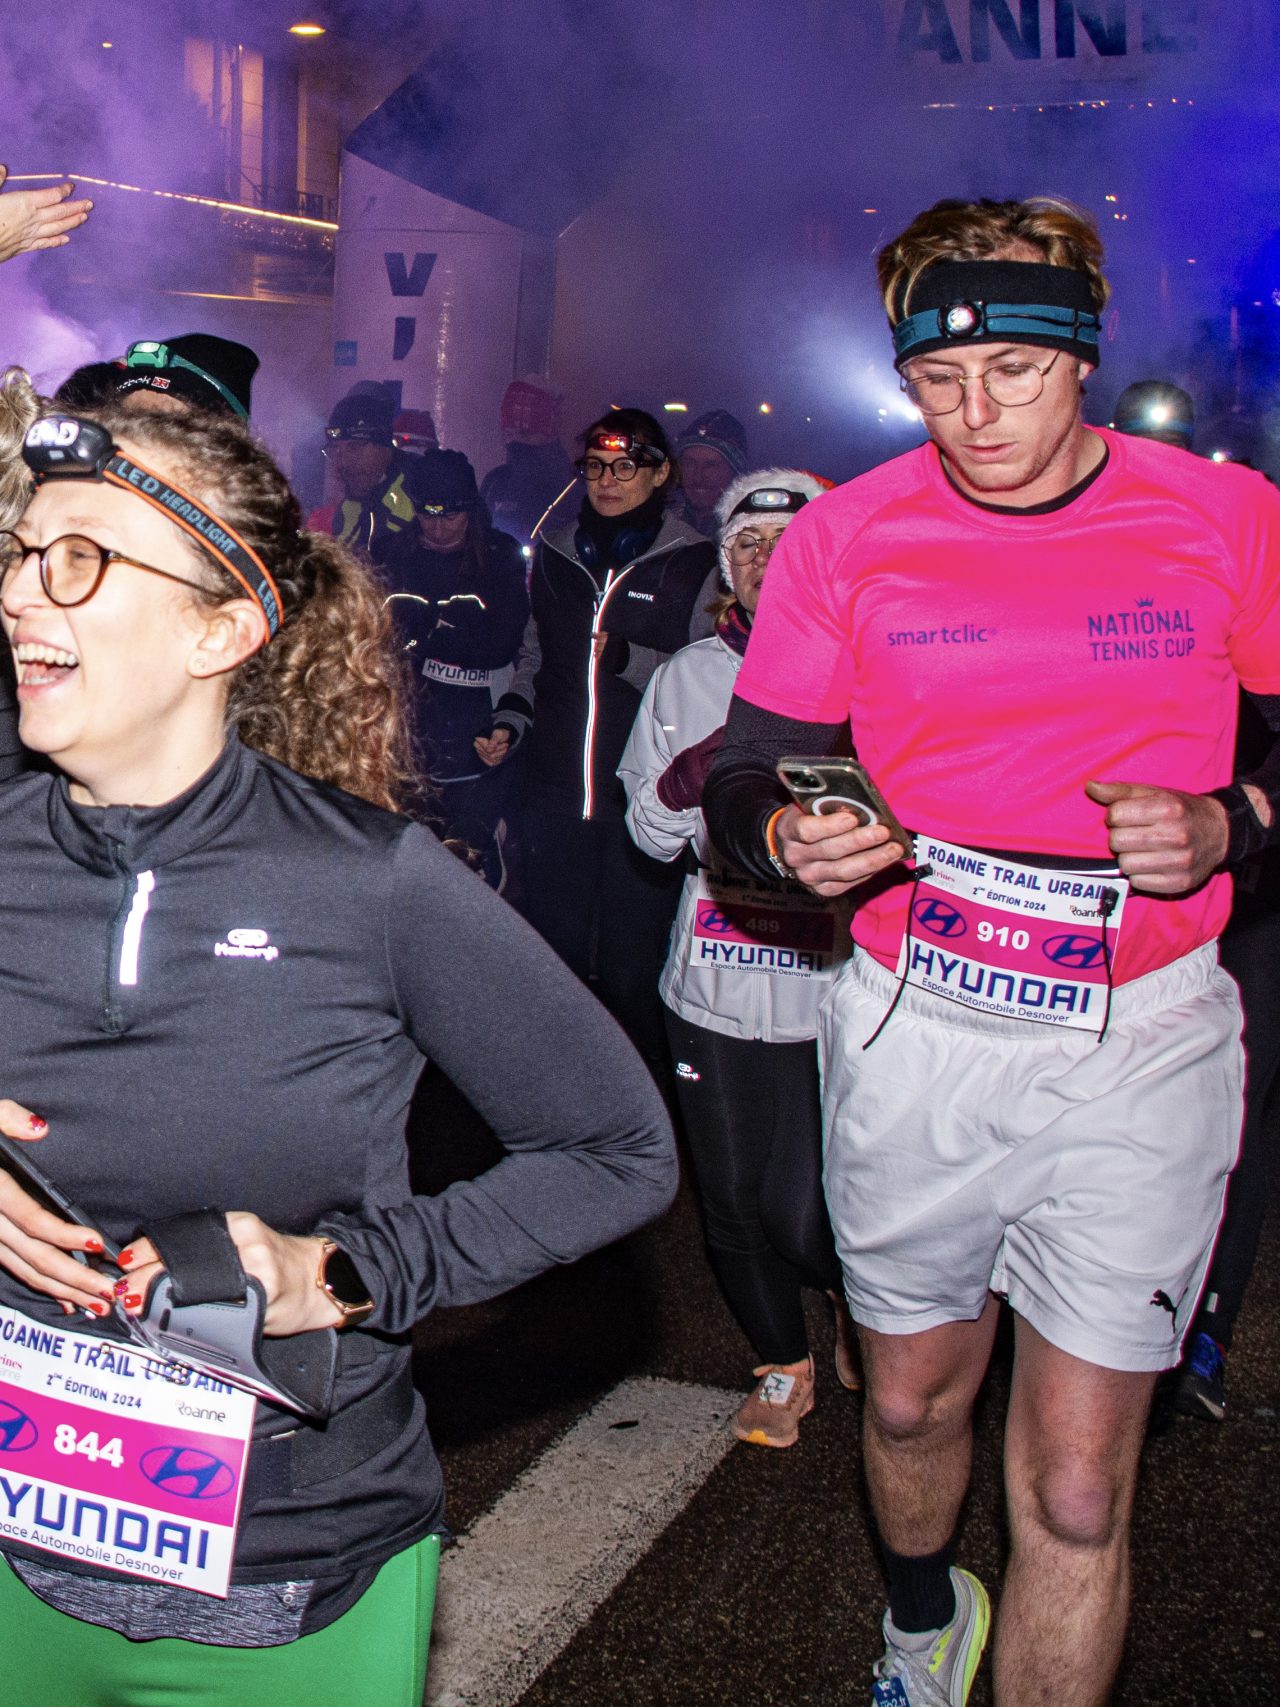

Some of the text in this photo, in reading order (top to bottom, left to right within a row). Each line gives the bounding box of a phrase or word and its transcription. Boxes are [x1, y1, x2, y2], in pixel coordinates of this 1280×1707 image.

[117, 460, 237, 554] LED HEADLIGHT
[628, 590, 654, 602] INOVIX
[887, 624, 988, 646] smartclic
[1087, 609, 1195, 637] NATIONAL
[1090, 638, 1195, 661] TENNIS CUP
[427, 660, 489, 681] HYUNDAI
[928, 845, 988, 877] ROANNE
[993, 866, 1041, 891] TRAIL
[932, 869, 955, 883] trines
[987, 889, 1021, 907] ÉDITION
[1024, 900, 1046, 912] 2024
[746, 918, 780, 933] 489
[977, 921, 1030, 950] 910
[701, 941, 823, 971] HYUNDAI
[711, 962, 812, 978] Espace Automobile Desnoyer
[911, 944, 1091, 1014] HYUNDAI
[922, 977, 1070, 1024] Espace Automobile Desnoyer
[73, 1342, 135, 1378] TRAIL
[64, 1377, 108, 1402] ÉDITION
[112, 1393, 142, 1409] 2024
[176, 1399, 226, 1423] Roanne
[53, 1424, 124, 1468] 844
[30, 1530, 111, 1563] Automobile
[115, 1553, 183, 1582] Desnoyer
